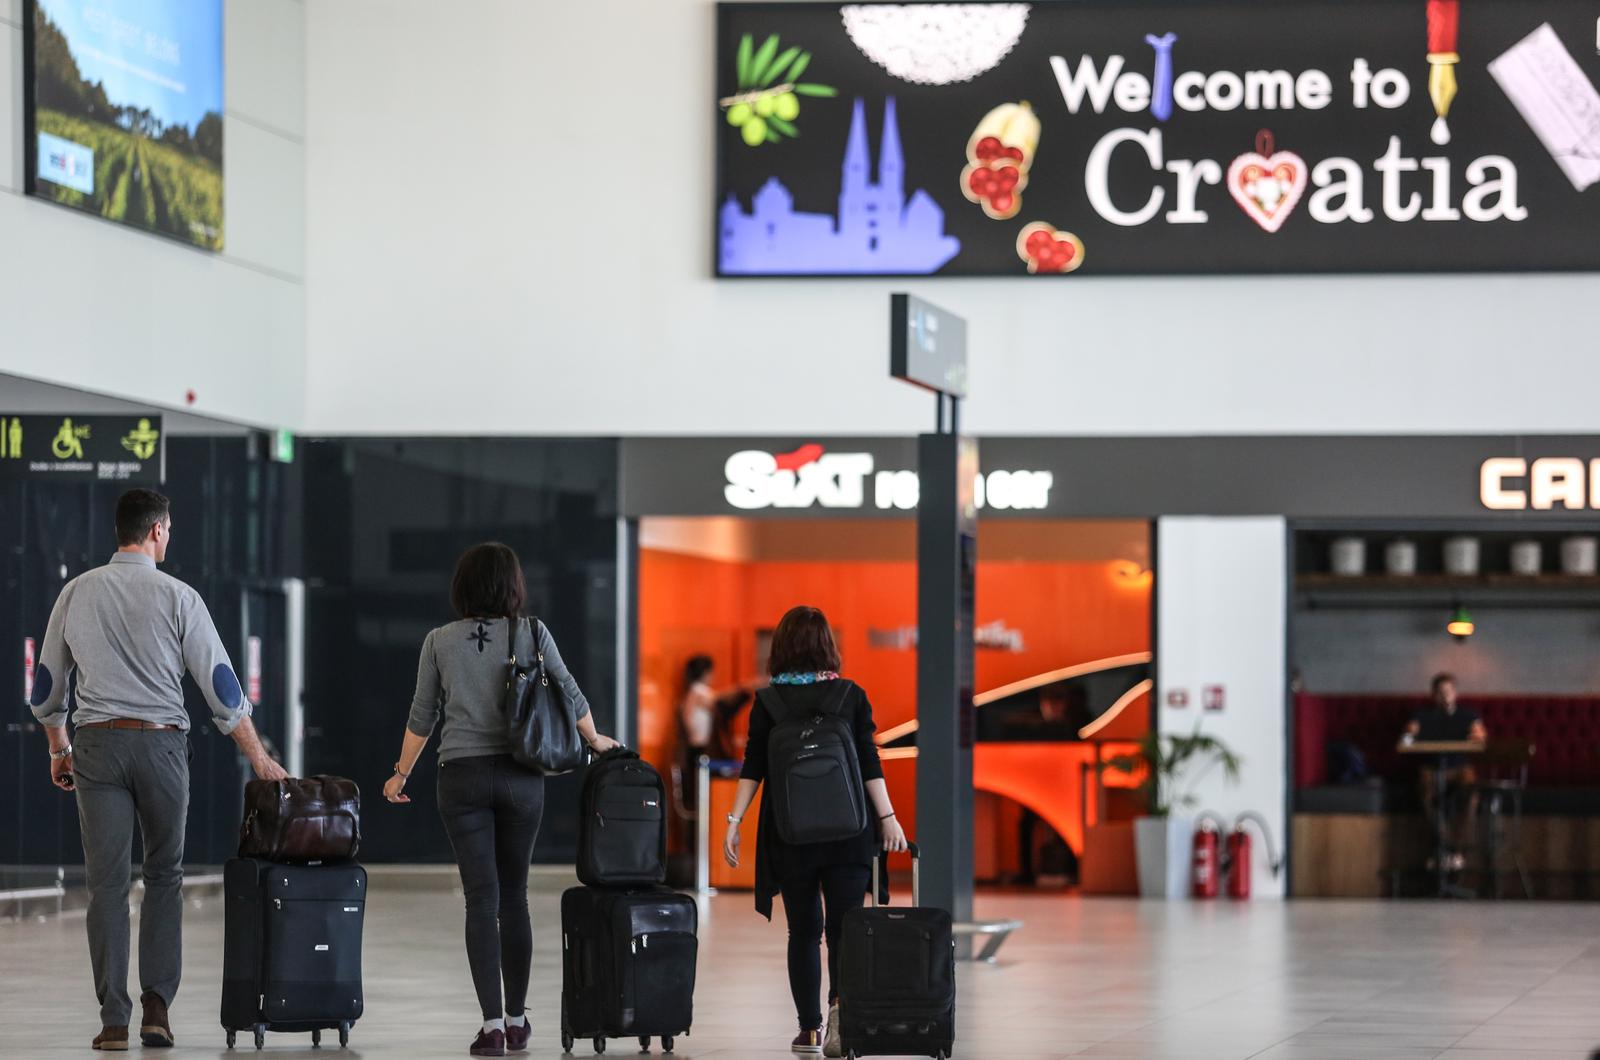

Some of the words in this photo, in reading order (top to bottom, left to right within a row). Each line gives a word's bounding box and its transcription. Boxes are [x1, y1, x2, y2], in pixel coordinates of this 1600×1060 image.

[1049, 33, 1332, 121] Welcome
[1350, 57, 1411, 108] to
[1085, 126, 1529, 231] Croatia
[1480, 457, 1600, 510] CA
